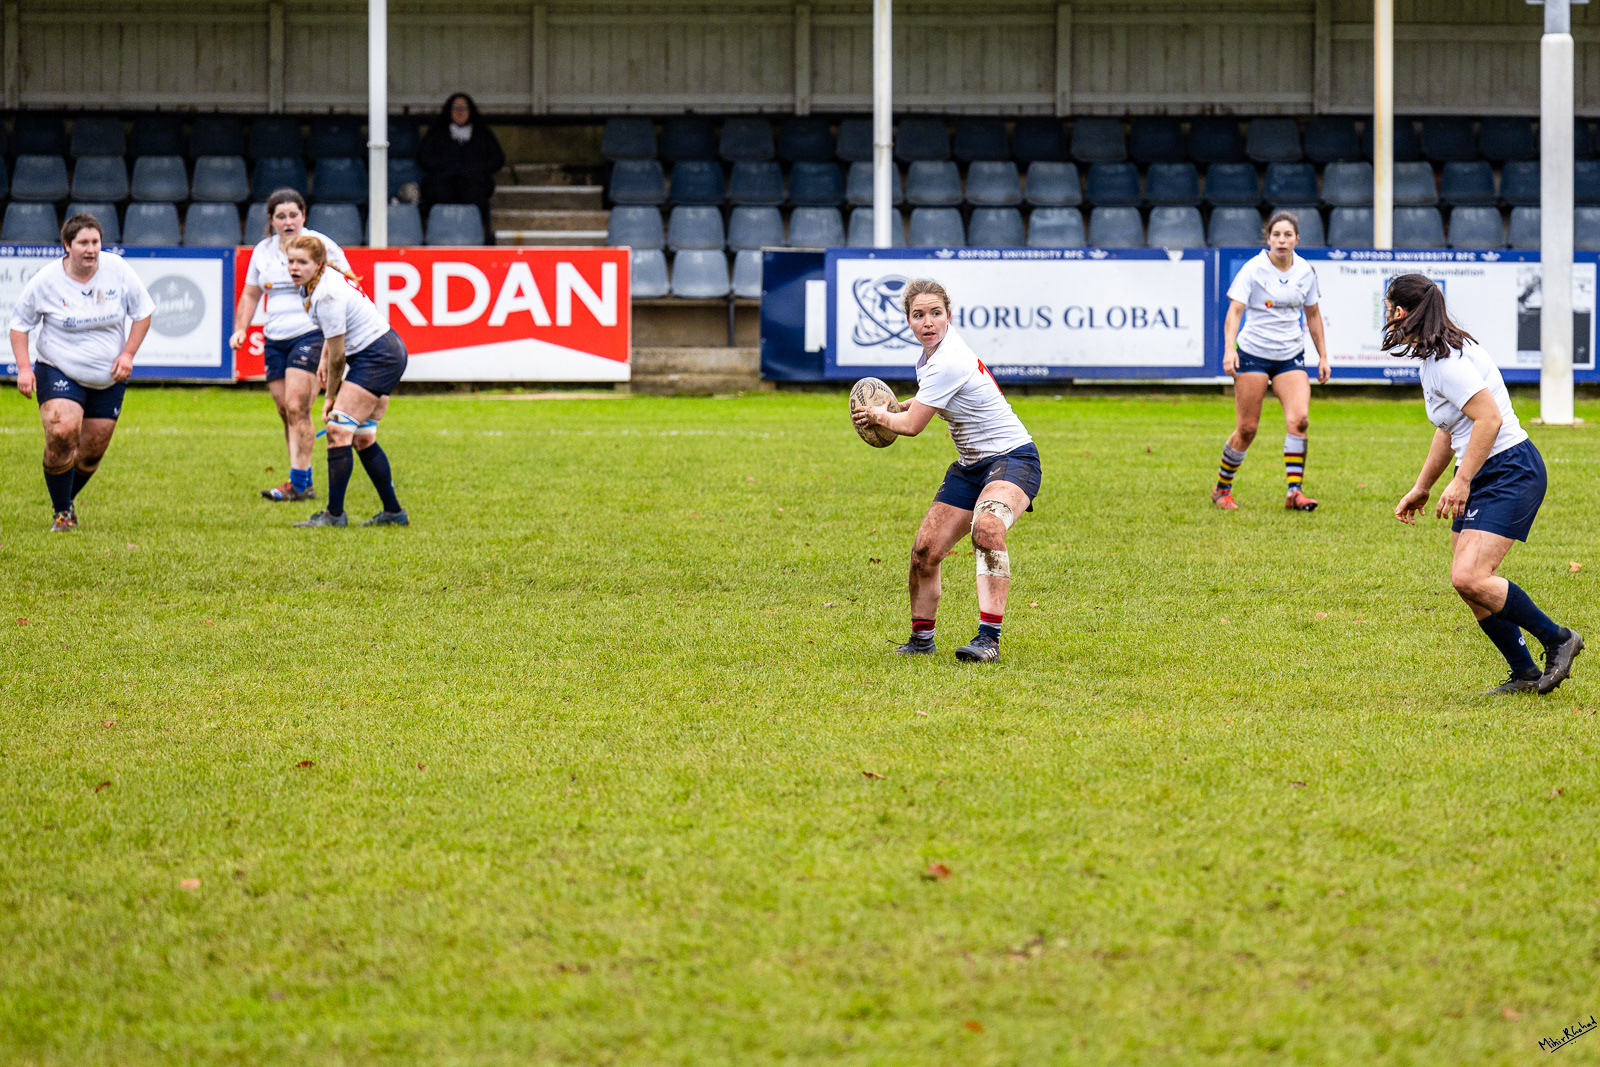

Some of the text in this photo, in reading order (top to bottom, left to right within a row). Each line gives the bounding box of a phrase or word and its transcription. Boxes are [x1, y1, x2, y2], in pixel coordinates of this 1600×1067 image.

[1, 246, 66, 257] RD UNIVERSI
[958, 250, 1084, 260] OXFORD UNIVERSITY RFC
[1350, 251, 1476, 261] OXFORD UNIVERSITY RFC
[1339, 266, 1359, 275] The
[1427, 266, 1485, 276] Foundation
[249, 261, 618, 326] RDAN
[1063, 305, 1189, 330] GLOBAL
[992, 366, 1049, 376] OURFC.ORG
[1383, 368, 1420, 378] OURFC.
